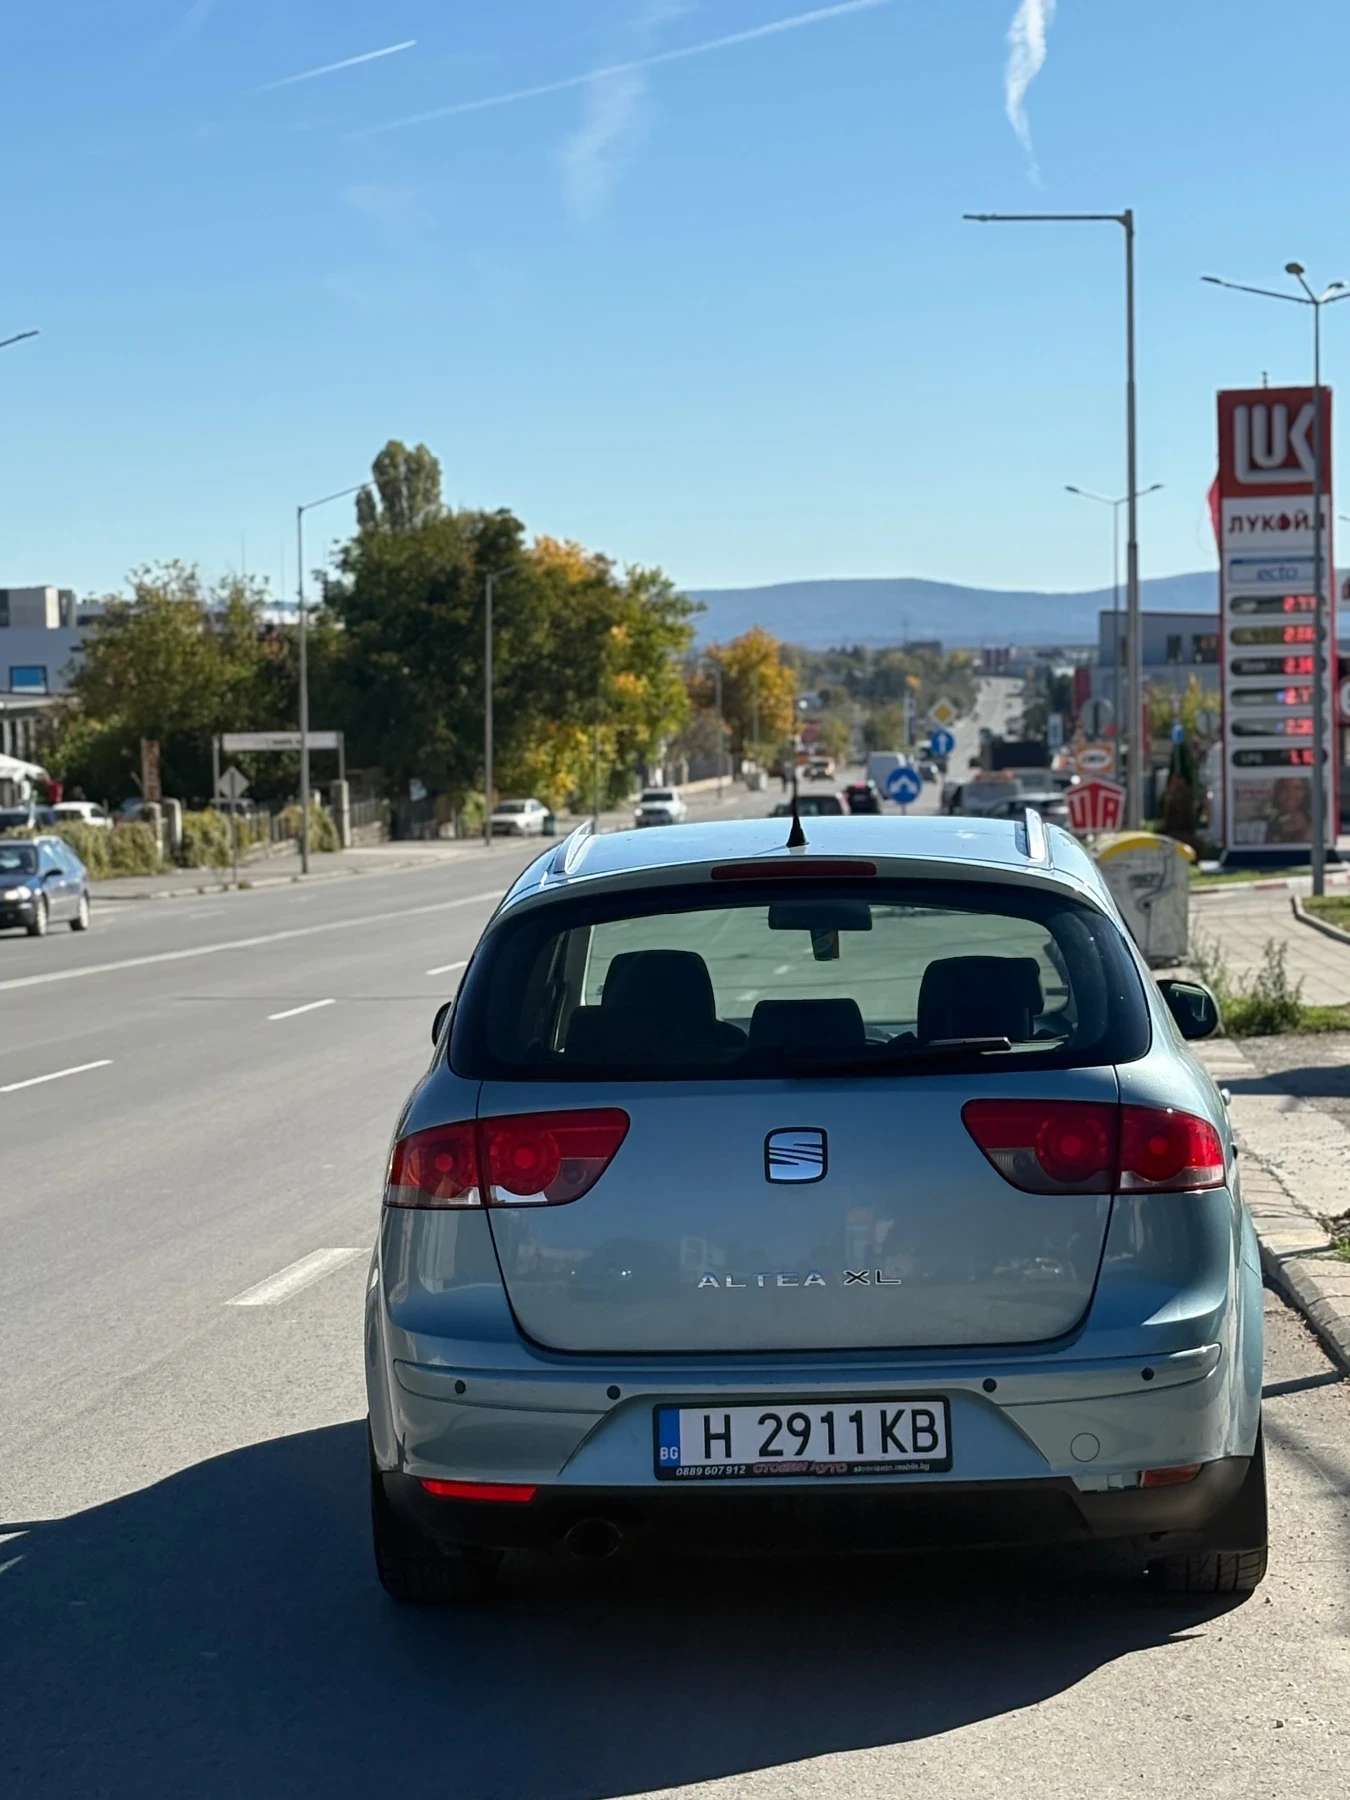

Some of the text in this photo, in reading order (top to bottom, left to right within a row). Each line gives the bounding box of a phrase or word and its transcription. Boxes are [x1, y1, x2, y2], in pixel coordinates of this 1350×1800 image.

[697, 1269, 902, 1289] ALTEA XL
[703, 1414, 732, 1459] H
[659, 1446, 679, 1460] BG
[675, 1467, 703, 1476] 0889
[704, 1466, 725, 1475] 607
[725, 1465, 746, 1474] 912
